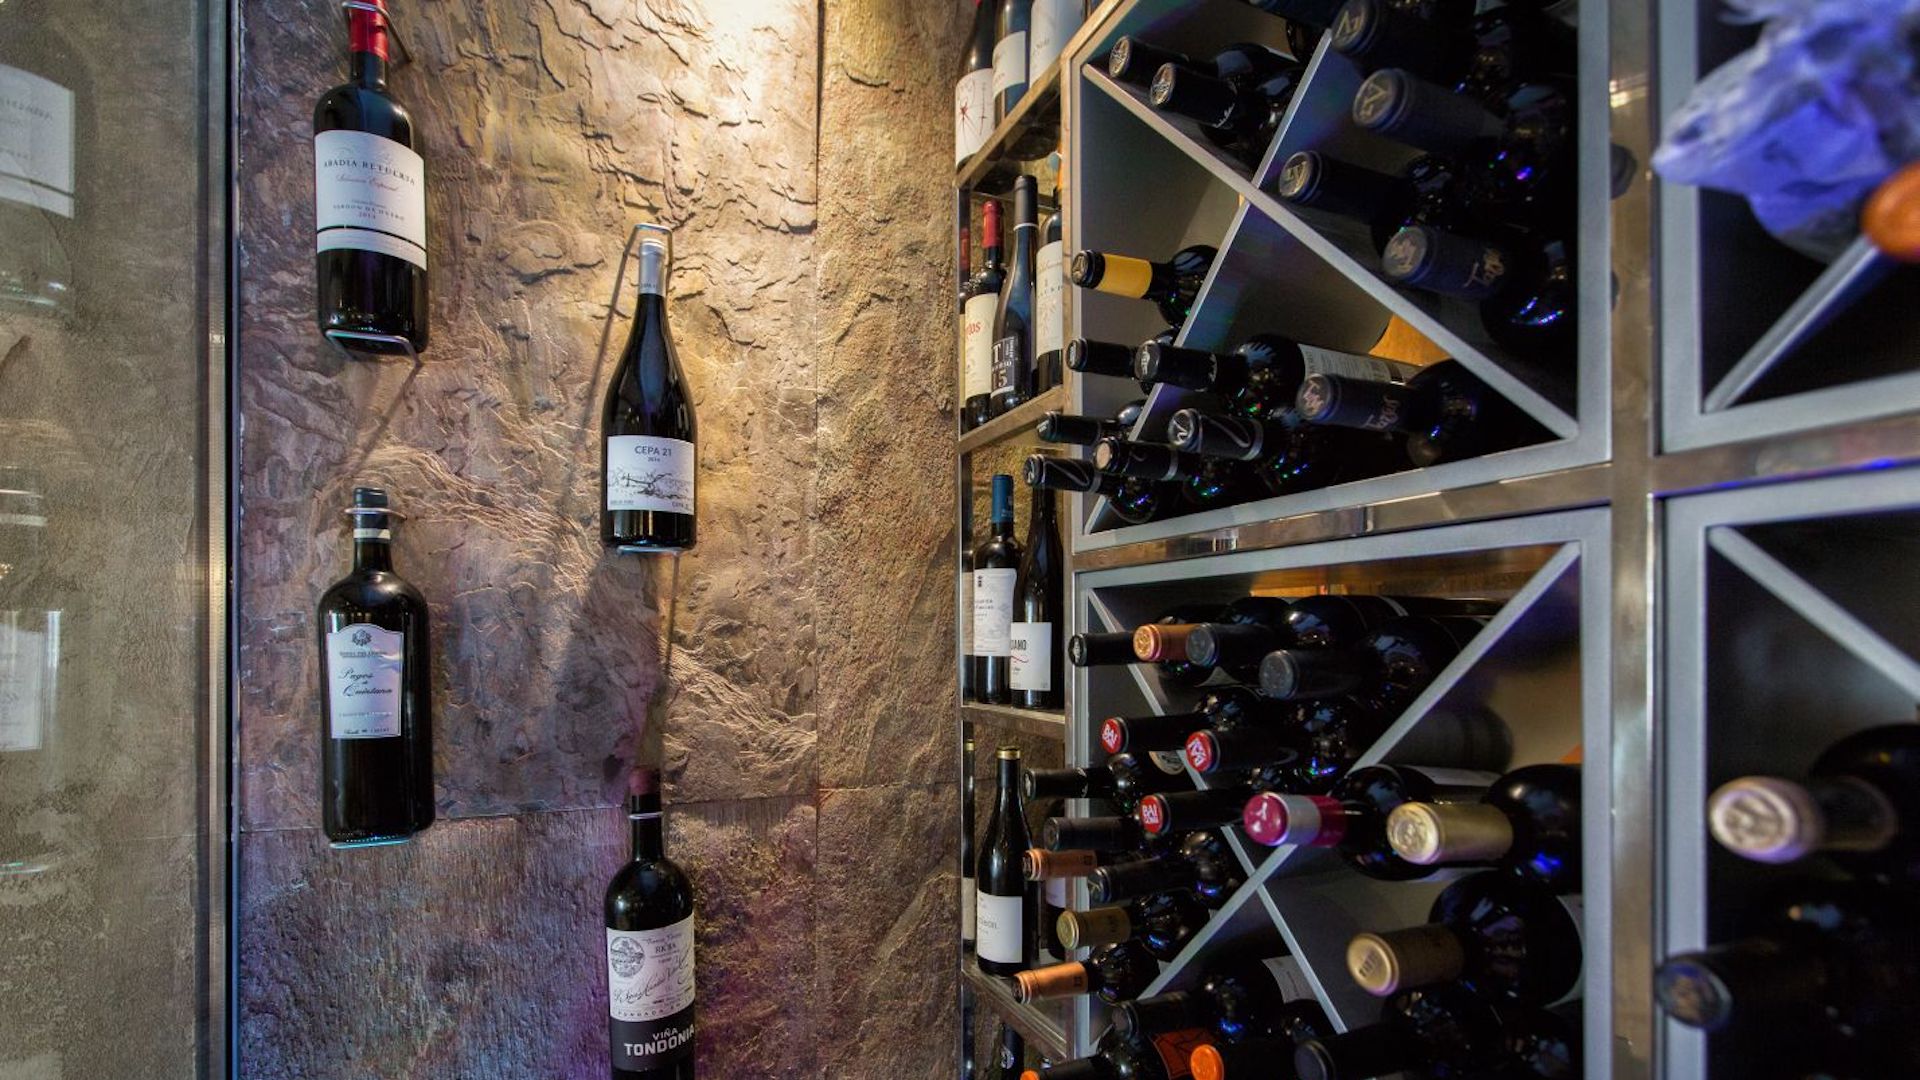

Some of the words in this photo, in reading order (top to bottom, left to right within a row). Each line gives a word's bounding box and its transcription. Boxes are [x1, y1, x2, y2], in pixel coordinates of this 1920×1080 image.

[634, 445, 660, 456] CEPA
[662, 447, 672, 457] 21
[623, 1023, 696, 1057] TONDONIA
[653, 1027, 678, 1040] VIÑA
